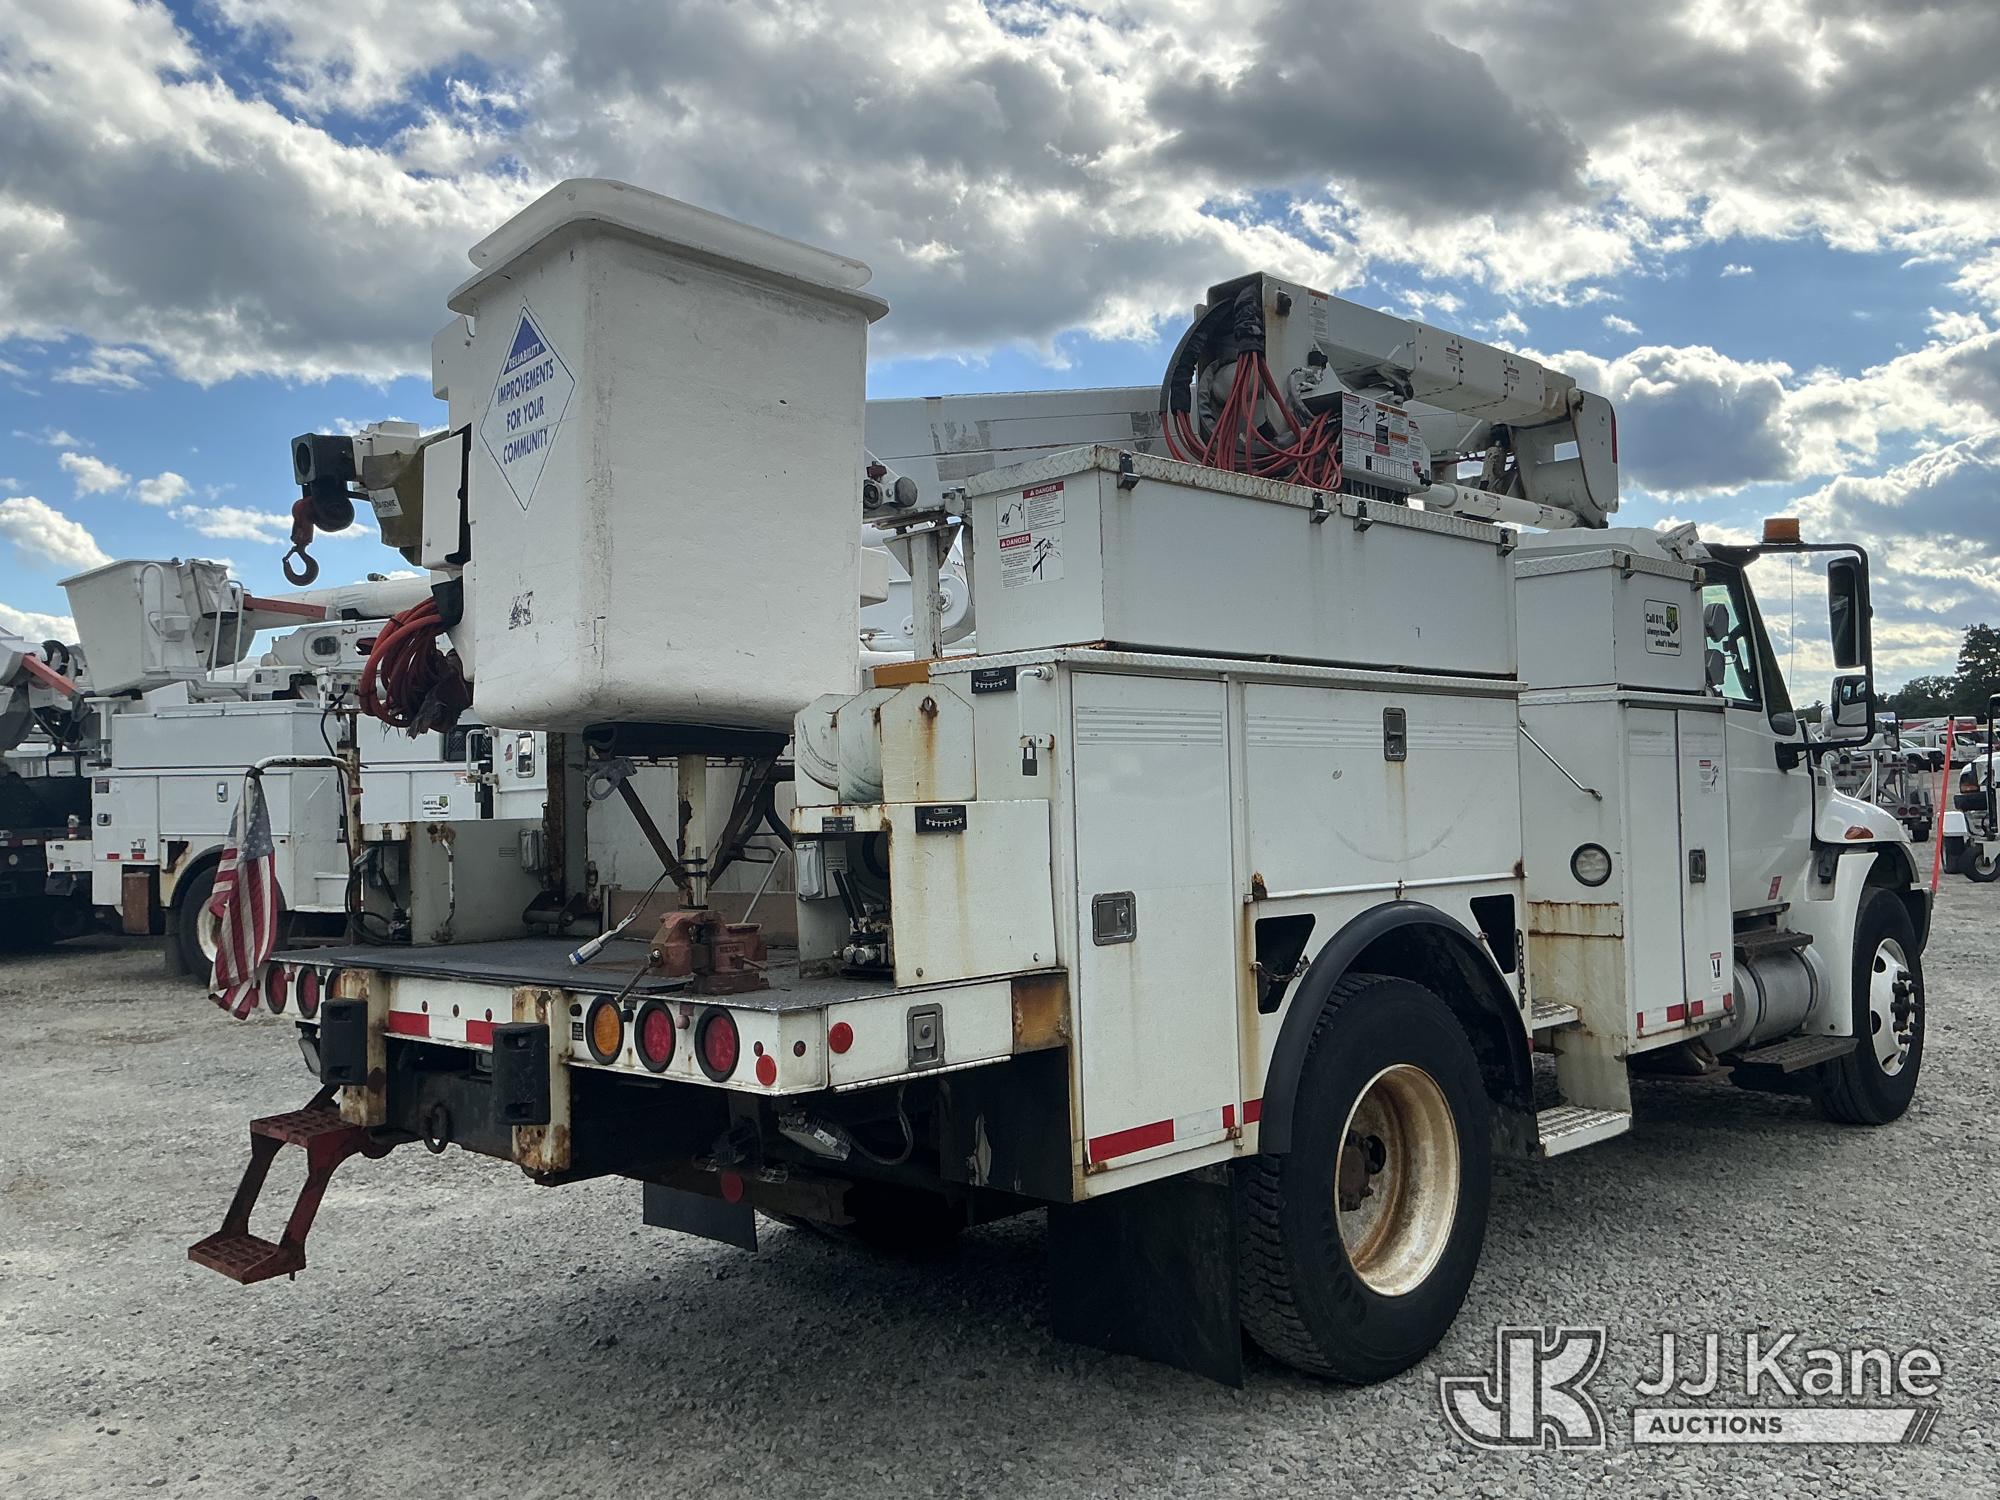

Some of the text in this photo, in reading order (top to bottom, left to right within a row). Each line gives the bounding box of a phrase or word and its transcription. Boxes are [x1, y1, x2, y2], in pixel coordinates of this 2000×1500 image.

[508, 342, 541, 369] RELIABILITY
[498, 358, 554, 407] IMPROVEMENTS
[507, 396, 544, 432] FOR YOUR
[503, 428, 549, 465] COMMUNITY
[1035, 485, 1057, 495] DANGER
[1006, 535, 1030, 547] DANGER
